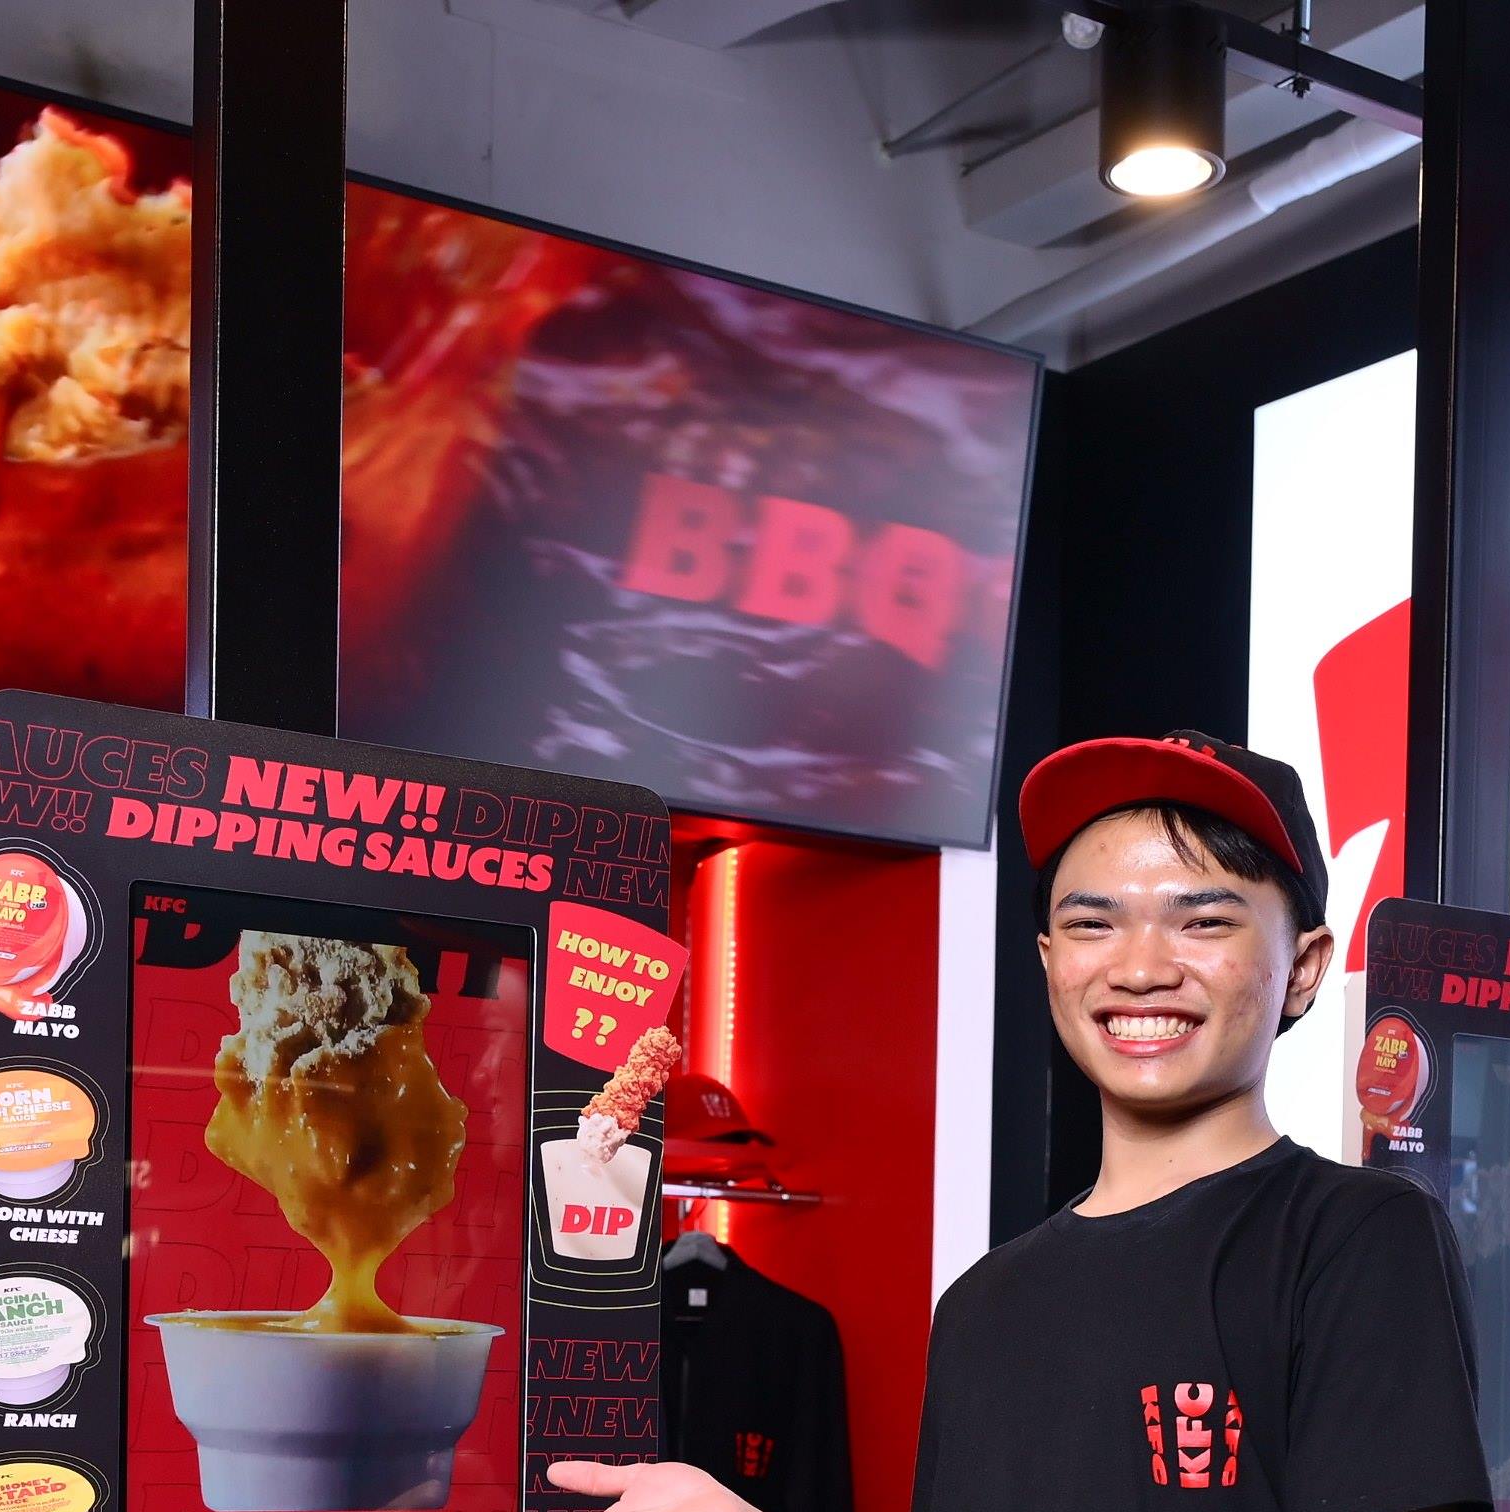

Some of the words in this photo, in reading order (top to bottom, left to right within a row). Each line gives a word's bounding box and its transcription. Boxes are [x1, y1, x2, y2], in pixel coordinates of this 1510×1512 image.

[622, 472, 966, 674] BBQ
[221, 754, 447, 833] NEW!!
[105, 796, 356, 868] DIPPING
[362, 834, 555, 892] SAUCES
[143, 895, 188, 914] KFC
[556, 929, 632, 969] HOW
[632, 953, 670, 981] TO
[568, 965, 655, 1008] ENJOY
[19, 1000, 77, 1020] ZABB
[12, 1019, 80, 1039] MAYO
[11, 1101, 72, 1117] CHEESE
[1392, 1125, 1423, 1139] ZABB
[1388, 1139, 1425, 1154] MAYO
[47, 1209, 104, 1226] WITH
[559, 1204, 634, 1236] DIP
[9, 1227, 80, 1244] CHEESE
[0, 1319, 34, 1328] SAUCE
[527, 1338, 660, 1382] NEW
[3, 1413, 78, 1428] RANCH
[1174, 1382, 1214, 1489] KFC
[0, 1477, 52, 1491] HONEY
